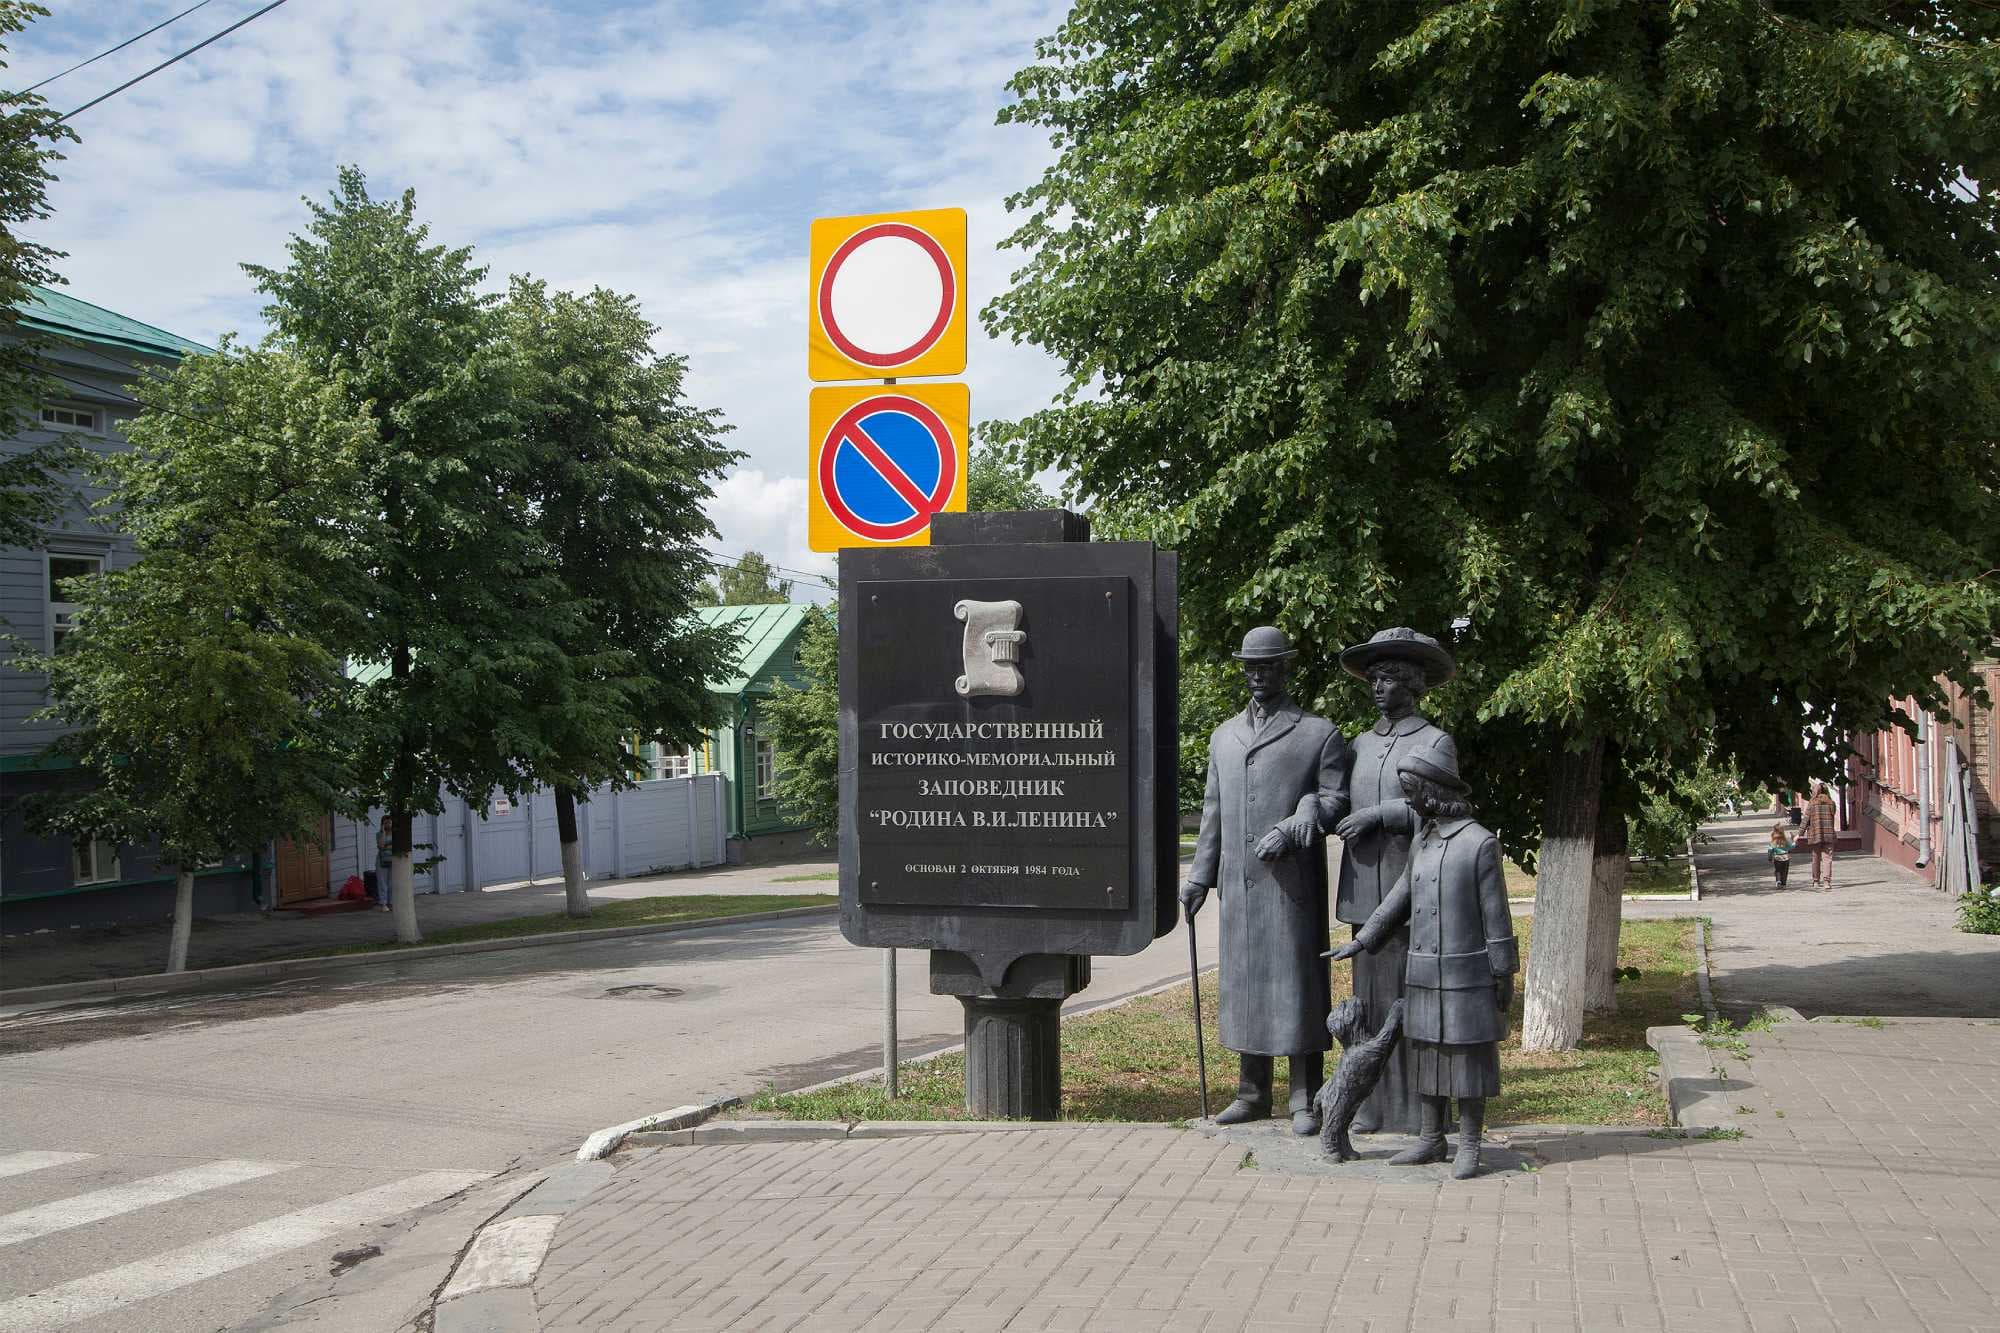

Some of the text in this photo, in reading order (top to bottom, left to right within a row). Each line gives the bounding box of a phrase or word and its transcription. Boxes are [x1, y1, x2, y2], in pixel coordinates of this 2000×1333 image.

[880, 719, 1104, 742] ГОСУДАРСТВЕННЫЙ
[871, 750, 1117, 766] ИСТОРИКО-МЕМОРИАЛЬНЫЙ
[918, 779, 1065, 800] ЗАПОВЕДНИК
[904, 863, 1081, 876] ОСНОВАН 2 ОКТЯБРЯ 1984 ГОДА
